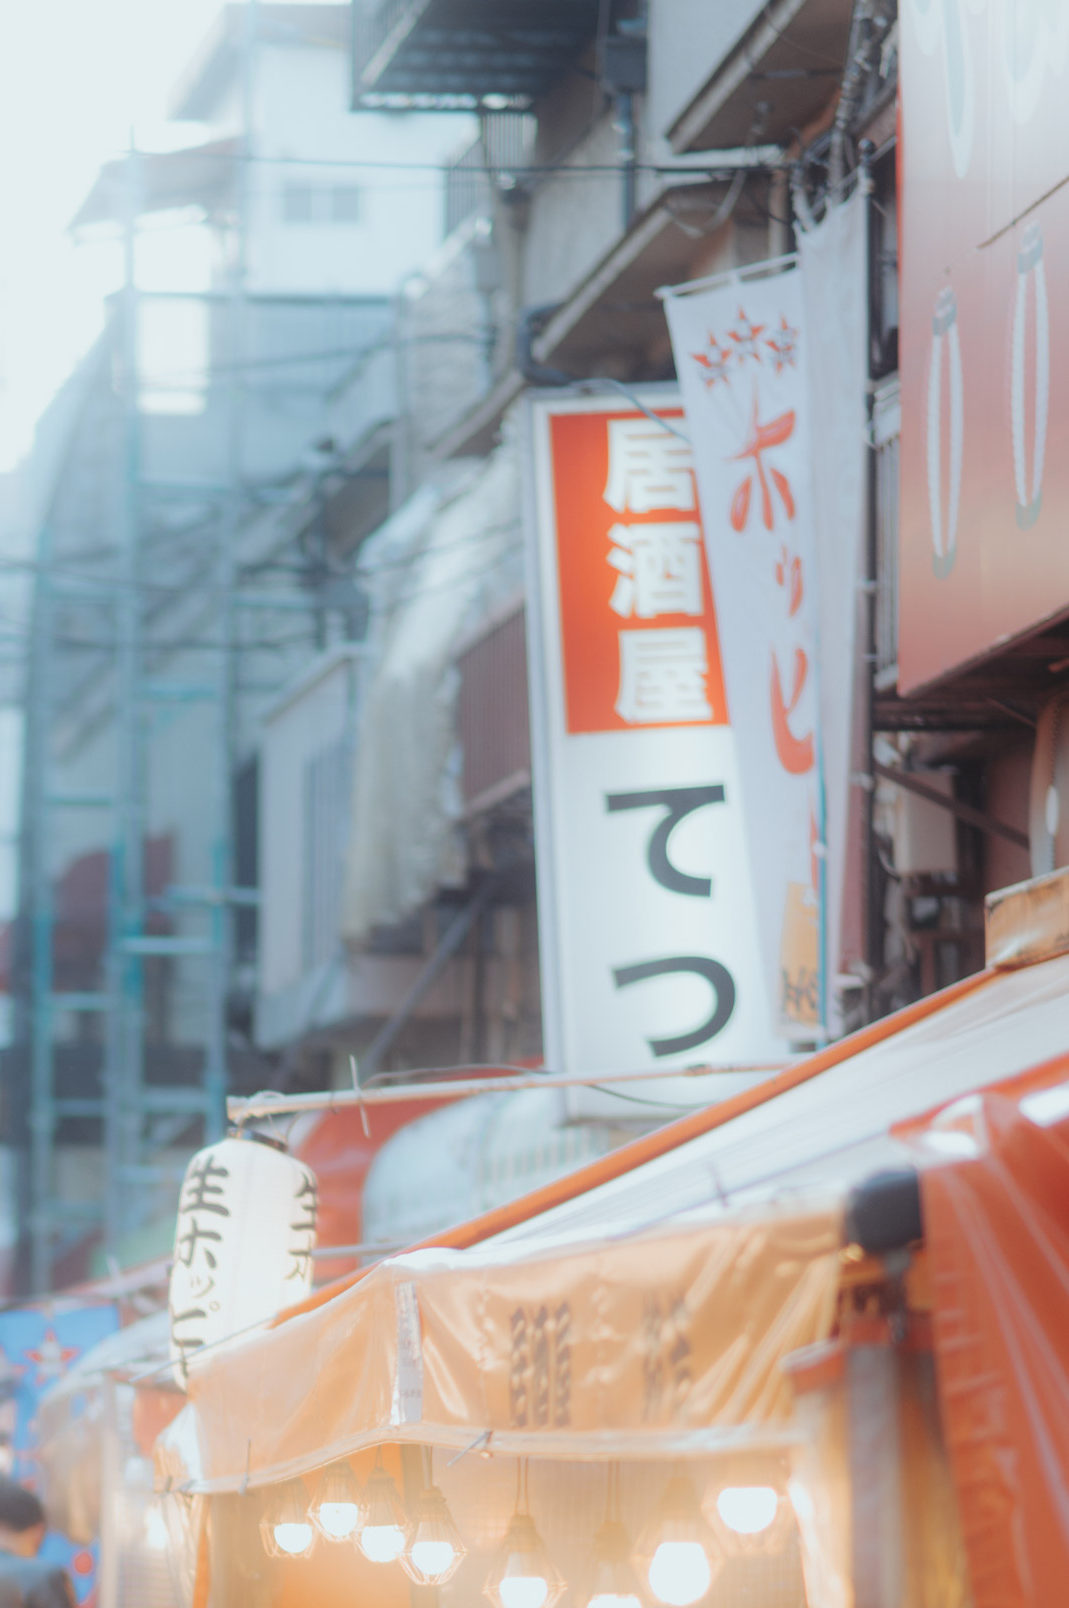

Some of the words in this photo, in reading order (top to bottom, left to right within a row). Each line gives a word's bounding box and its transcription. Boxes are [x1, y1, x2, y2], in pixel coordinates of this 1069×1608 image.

[603, 416, 715, 725] 居酒屋
[605, 783, 736, 1059] てつ
